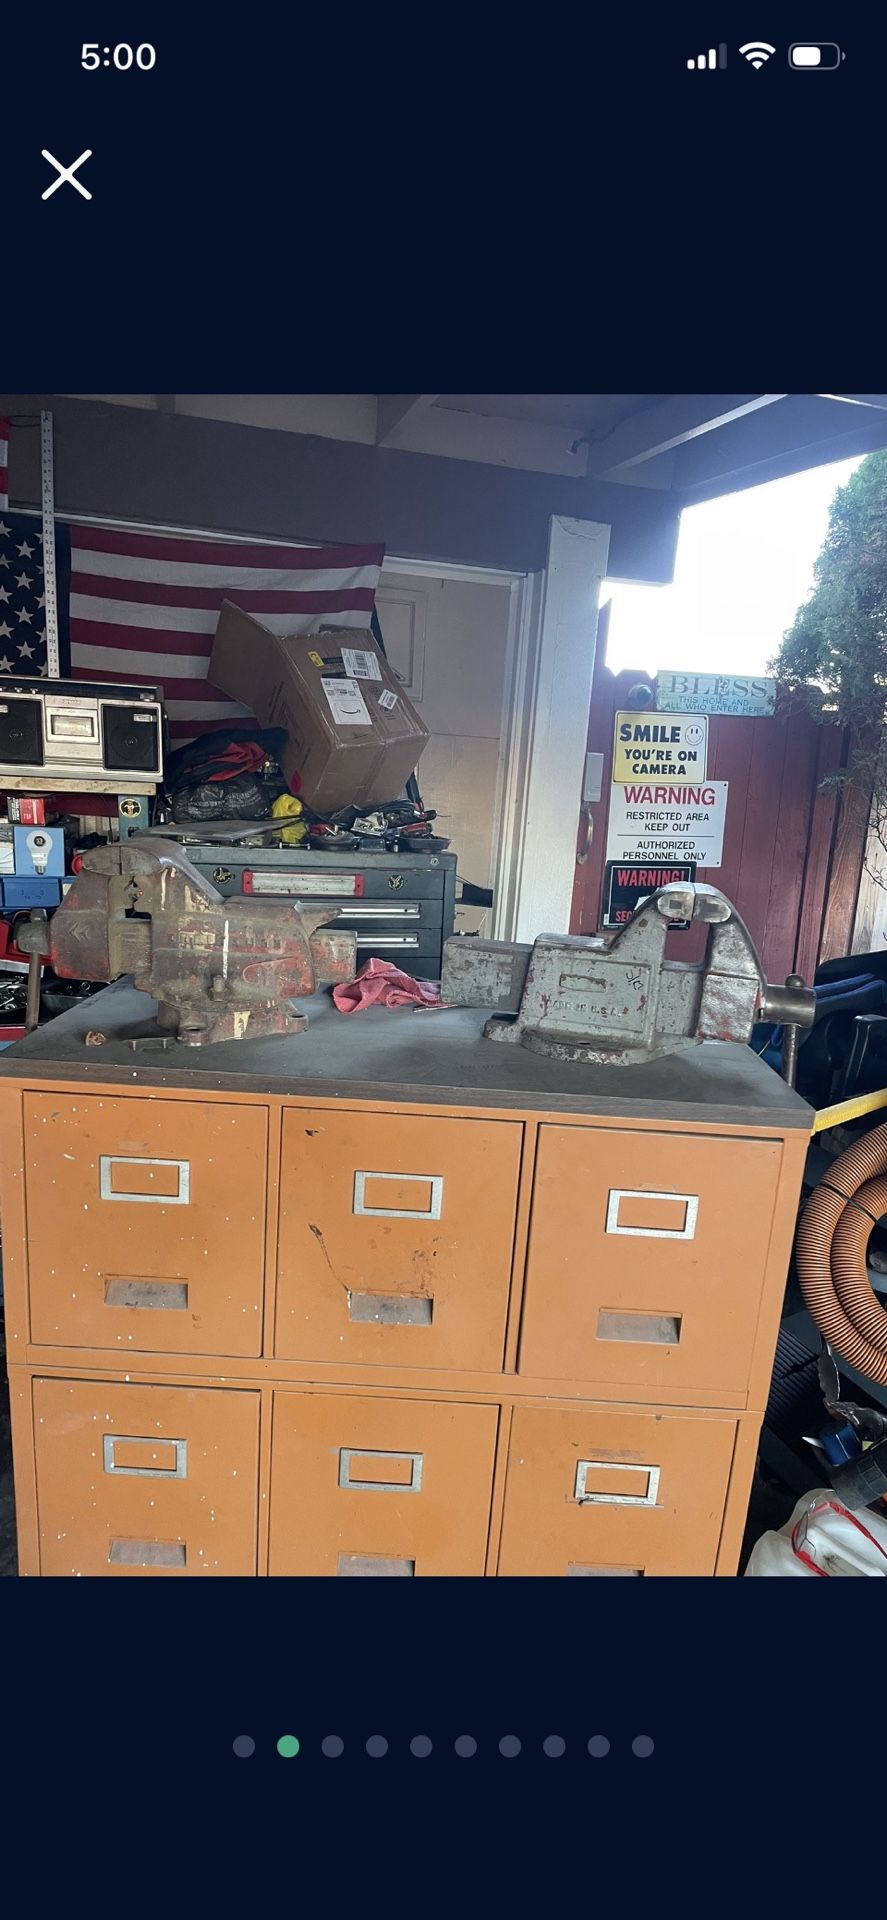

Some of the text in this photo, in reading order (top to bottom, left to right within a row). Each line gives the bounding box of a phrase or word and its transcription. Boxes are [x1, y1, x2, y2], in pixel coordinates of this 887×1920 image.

[668, 675, 768, 698] BLESS
[702, 697, 728, 705] HOME
[686, 703, 707, 711] WHO
[620, 723, 681, 743] SMILE
[624, 749, 697, 761] YOU'RE ON
[632, 763, 687, 775] CAMERA
[624, 785, 716, 806] WARNING
[626, 811, 709, 821] RESTRICTED AREA
[644, 822, 690, 832] KEEP OUT
[637, 841, 695, 850] AUTHORIZED
[622, 851, 706, 860] PERSONNEL ONLY
[617, 869, 685, 887] WARNING!
